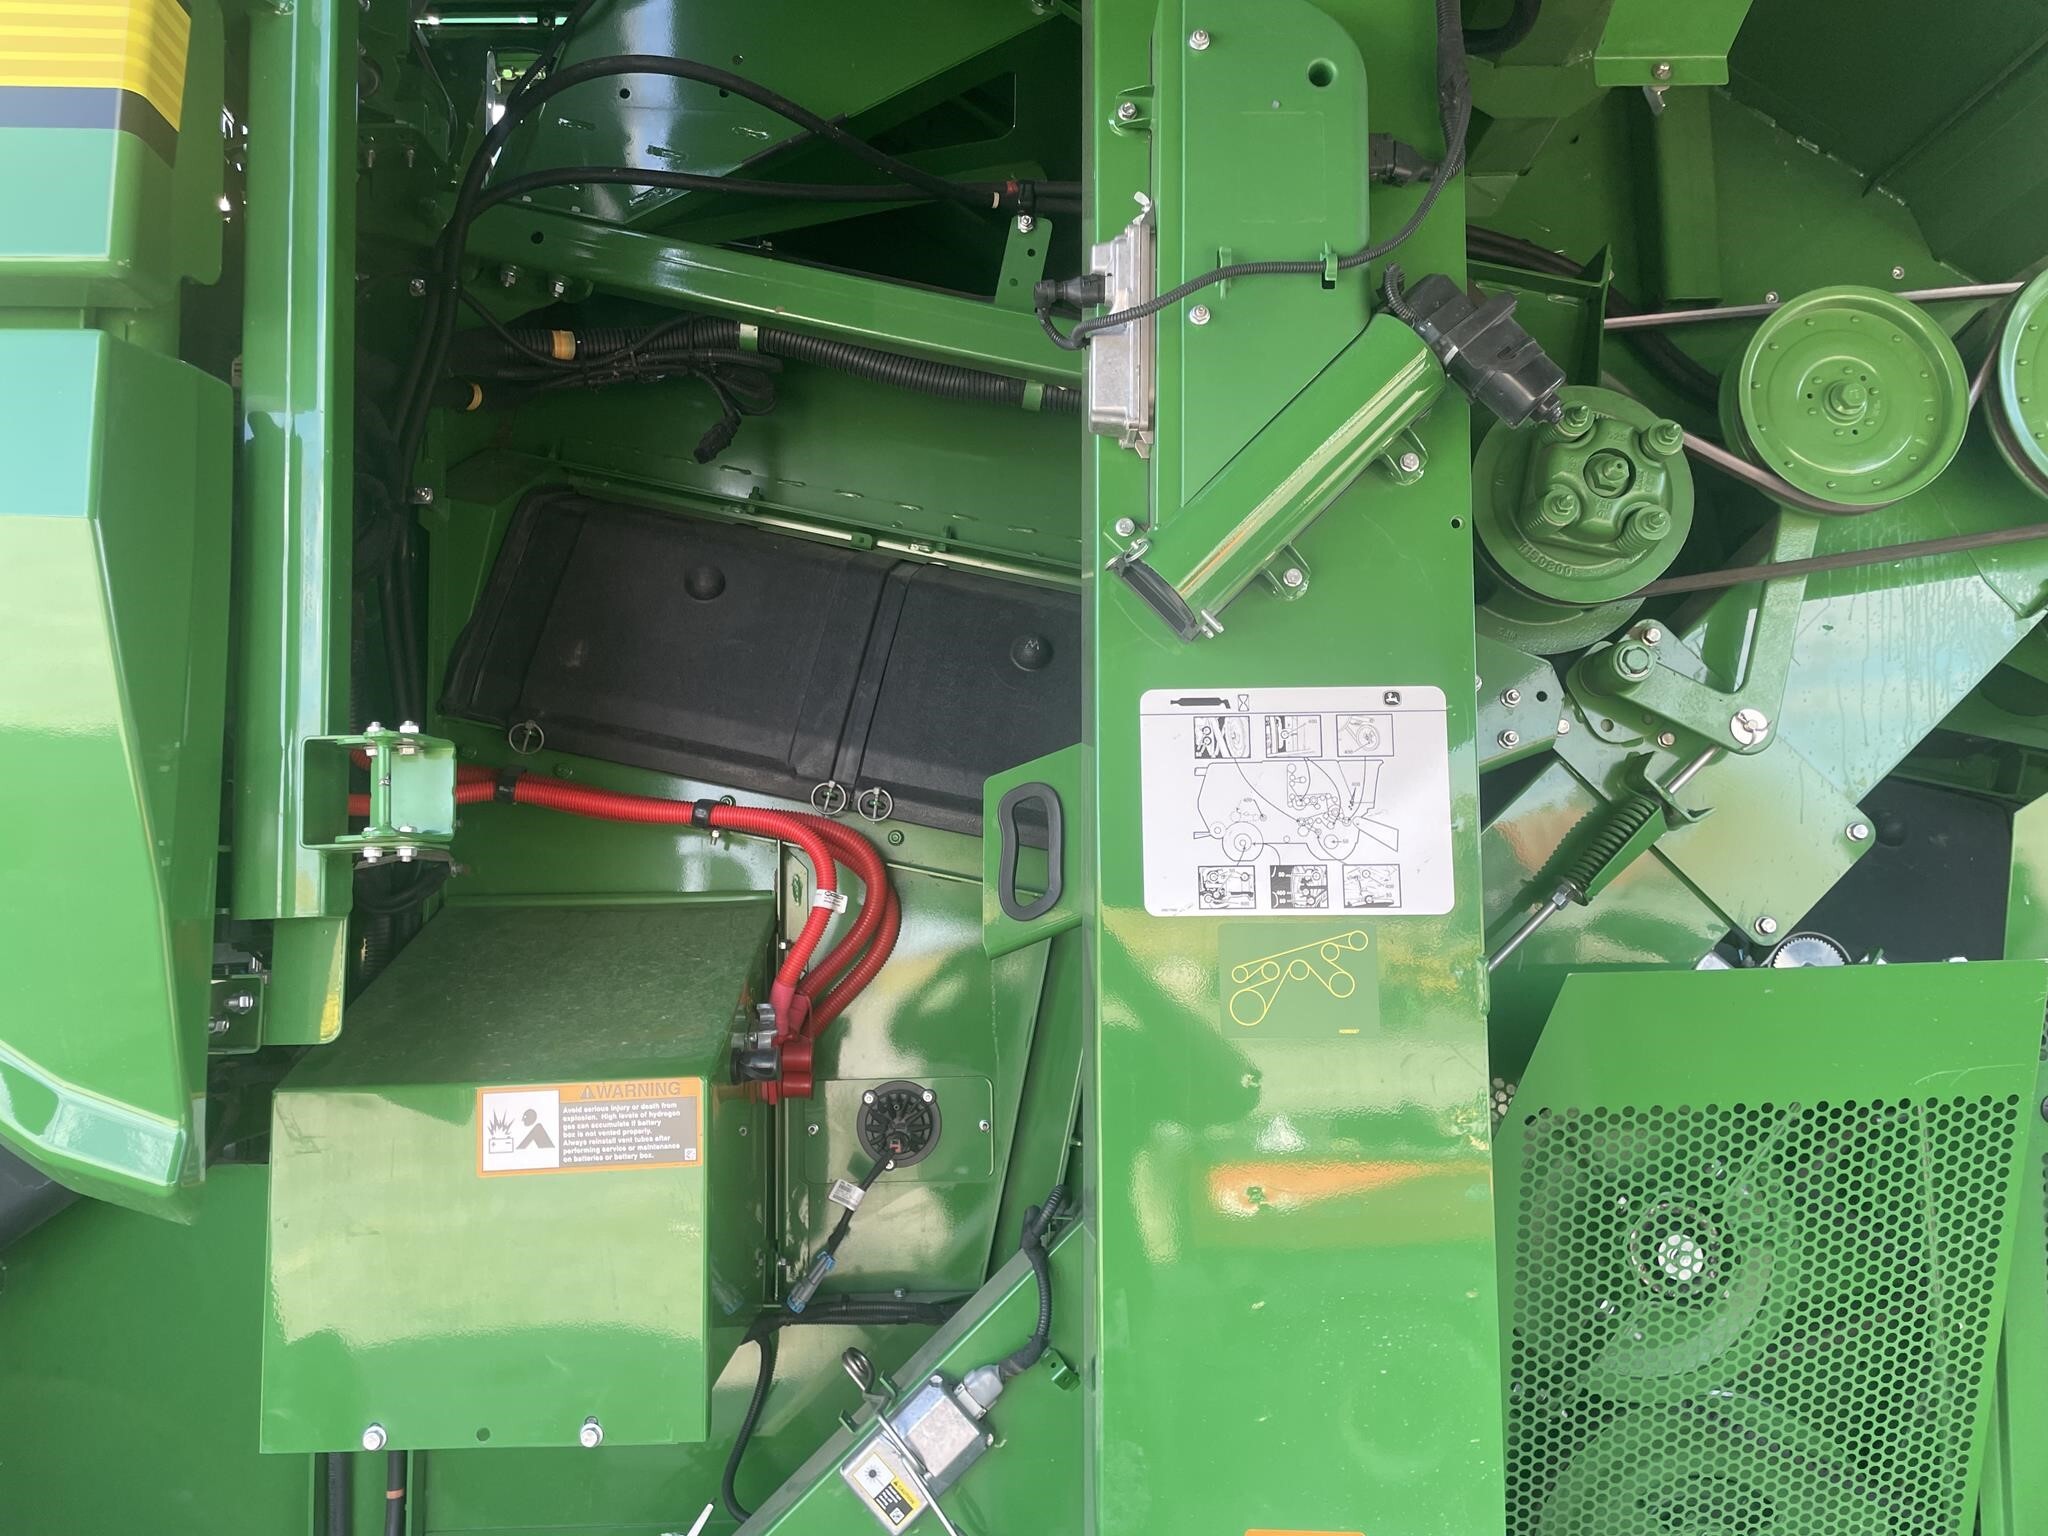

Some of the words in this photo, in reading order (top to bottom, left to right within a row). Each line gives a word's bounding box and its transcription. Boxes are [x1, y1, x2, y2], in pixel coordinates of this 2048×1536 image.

[596, 1082, 680, 1098] WARNING
[610, 1105, 631, 1113] injury
[562, 1114, 598, 1123] explosion.
[600, 1113, 617, 1121] High
[648, 1110, 681, 1119] hydrogen
[631, 1119, 636, 1127] if
[637, 1119, 662, 1127] battery
[622, 1127, 653, 1137] properly.
[563, 1139, 587, 1147] Always
[588, 1137, 617, 1145] reinstall
[563, 1147, 601, 1156] performing
[601, 1145, 627, 1153] service
[636, 1143, 681, 1151] maintenance
[573, 1154, 604, 1163] batteries
[613, 1153, 638, 1161] battery
